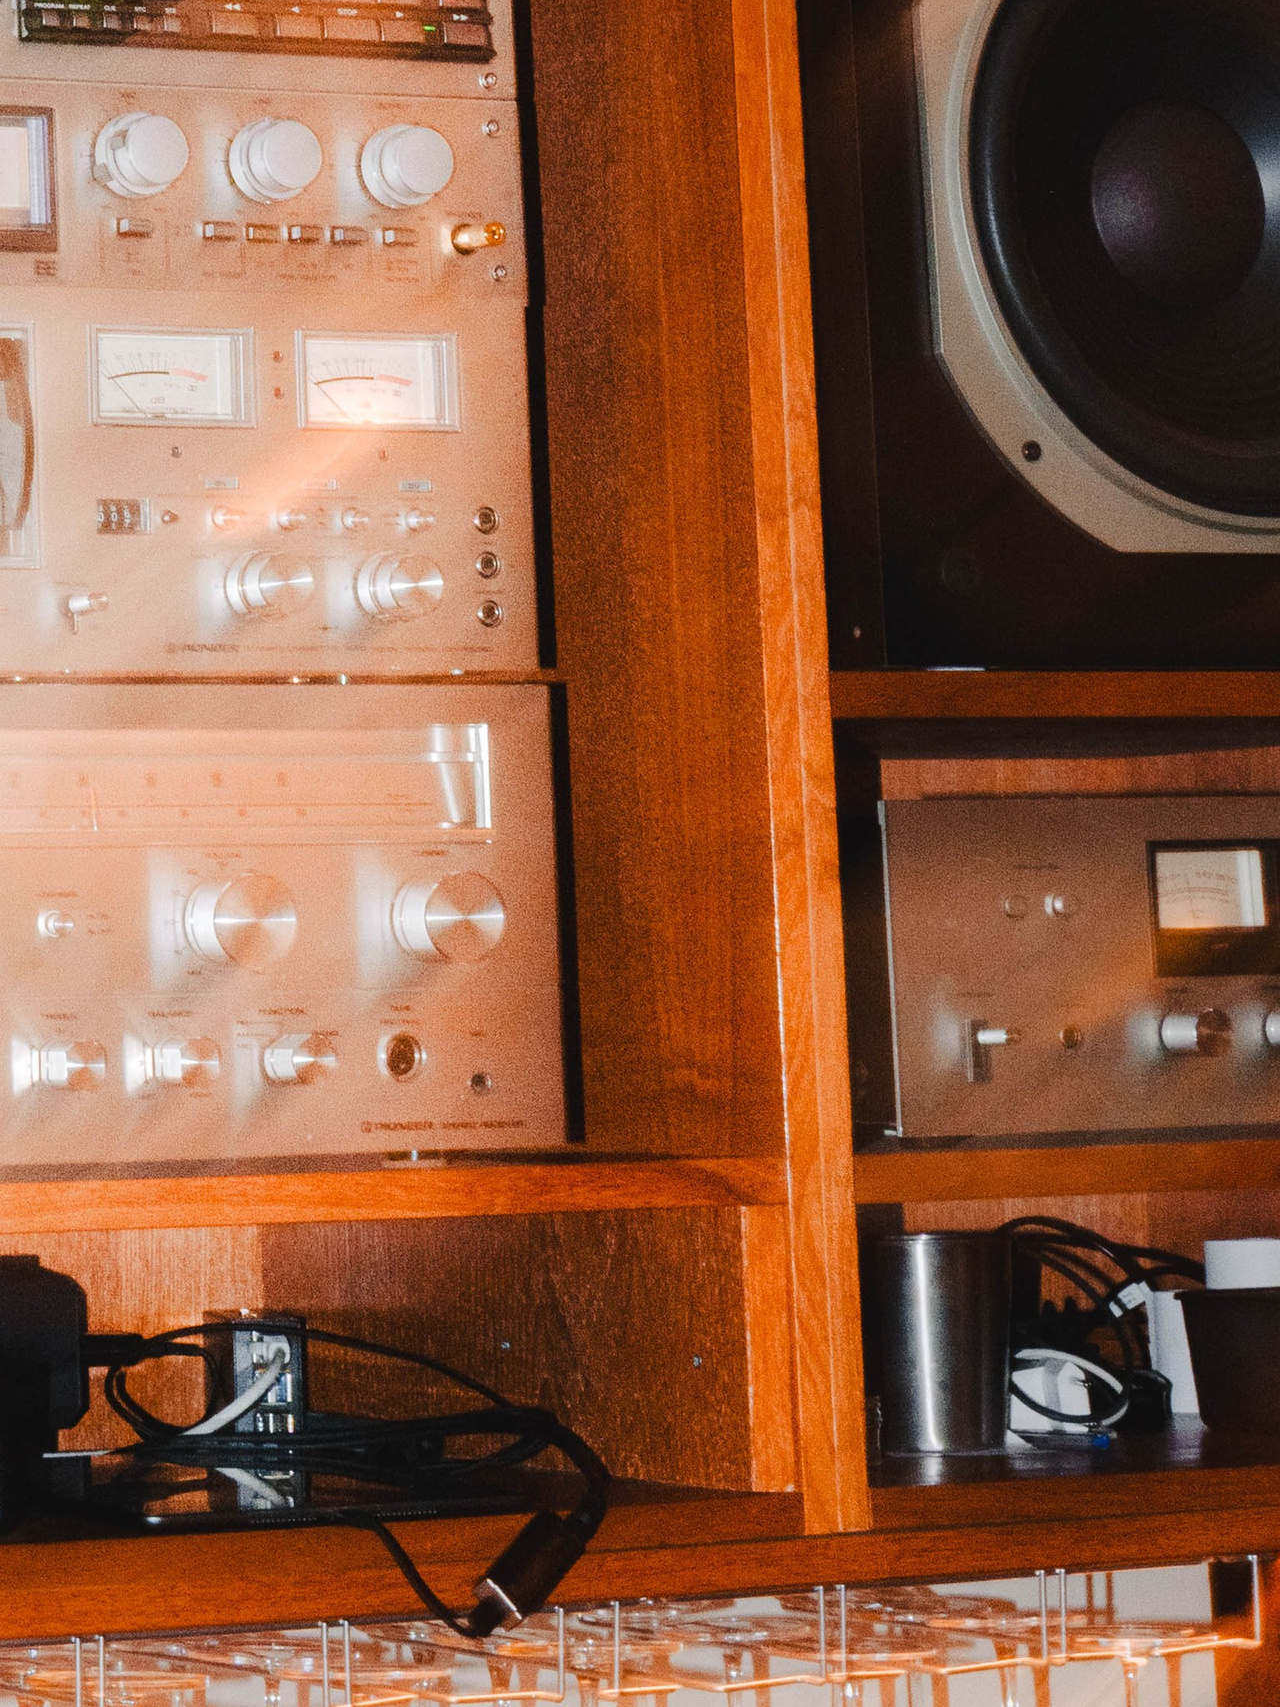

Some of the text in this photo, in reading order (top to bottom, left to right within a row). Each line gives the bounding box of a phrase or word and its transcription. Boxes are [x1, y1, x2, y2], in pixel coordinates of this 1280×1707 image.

[33, 2, 65, 10] PROGRAM
[68, 3, 91, 11] REPEAT
[337, 8, 358, 16] STOP
